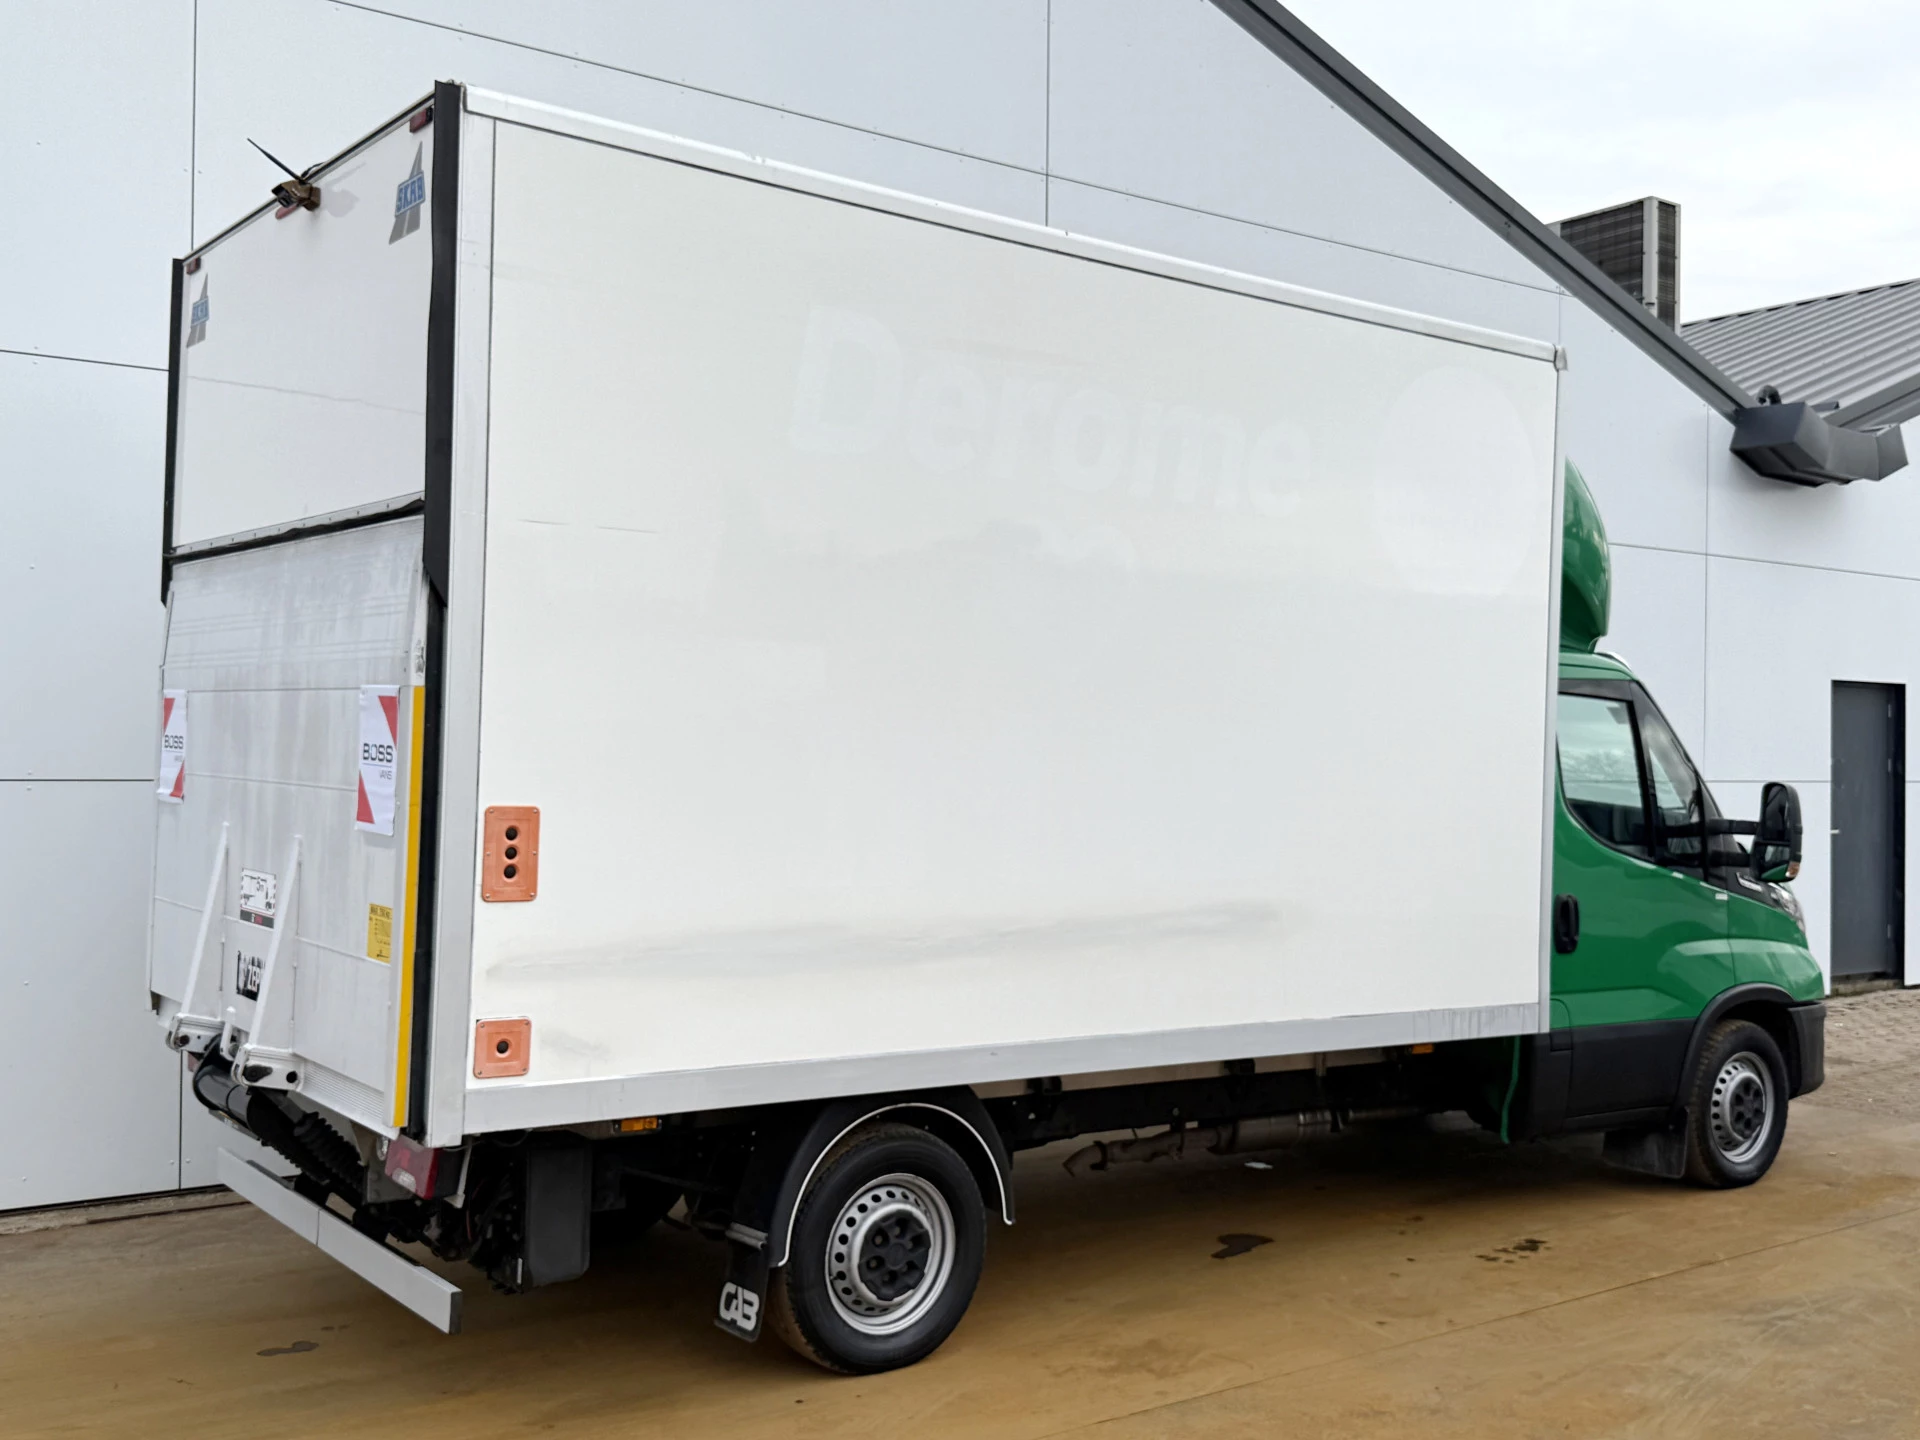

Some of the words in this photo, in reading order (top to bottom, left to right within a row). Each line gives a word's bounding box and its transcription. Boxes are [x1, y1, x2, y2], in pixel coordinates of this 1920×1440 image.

[396, 175, 424, 214] SKAB
[788, 302, 1313, 517] Derome
[163, 734, 184, 750] BOSS
[363, 743, 394, 763] BOSS
